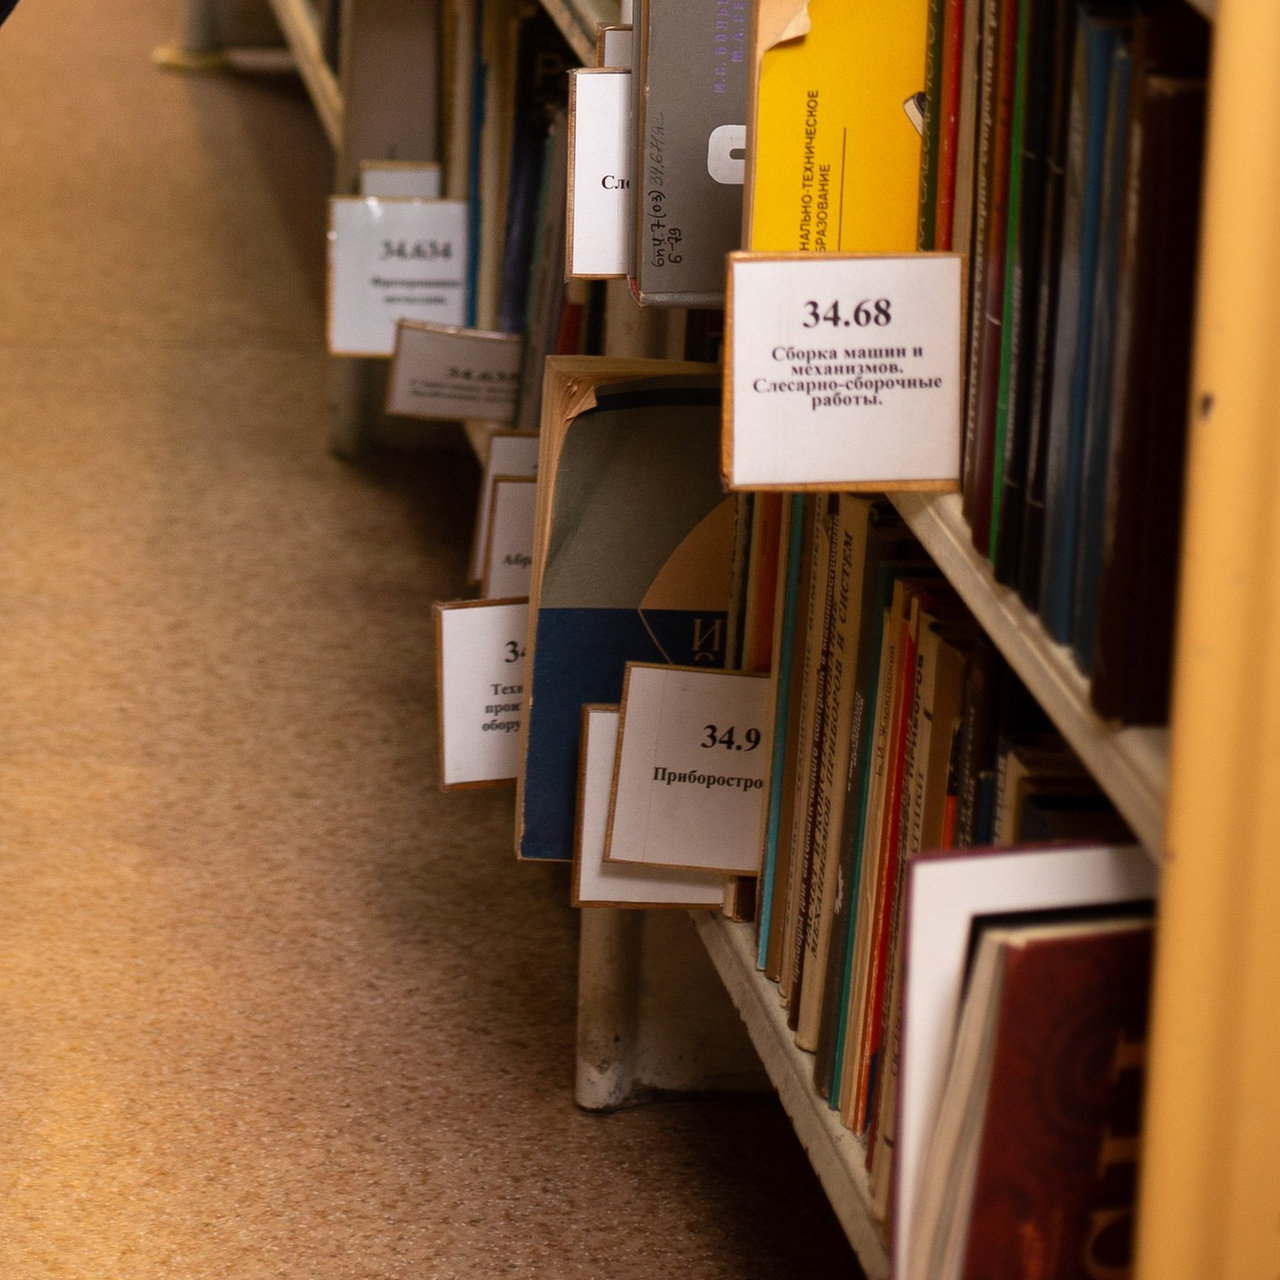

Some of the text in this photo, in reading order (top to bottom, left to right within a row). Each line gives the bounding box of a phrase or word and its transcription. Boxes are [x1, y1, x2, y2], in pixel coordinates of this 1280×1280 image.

[800, 90, 819, 251] НАЛЬНО-ТЕХНИЧЕСКОЕ
[802, 298, 893, 328] 34.68
[771, 345, 924, 363] Сборка машин и
[791, 362, 904, 376] механизмов.
[753, 377, 943, 395] Слесарно-сборочные
[811, 392, 883, 411] работы.
[700, 724, 762, 752] 34.9
[810, 530, 853, 960] МЕХАНИЗМОВ ПРИБОРОВ И СИСТЕМ
[653, 766, 764, 790] Приборостро
